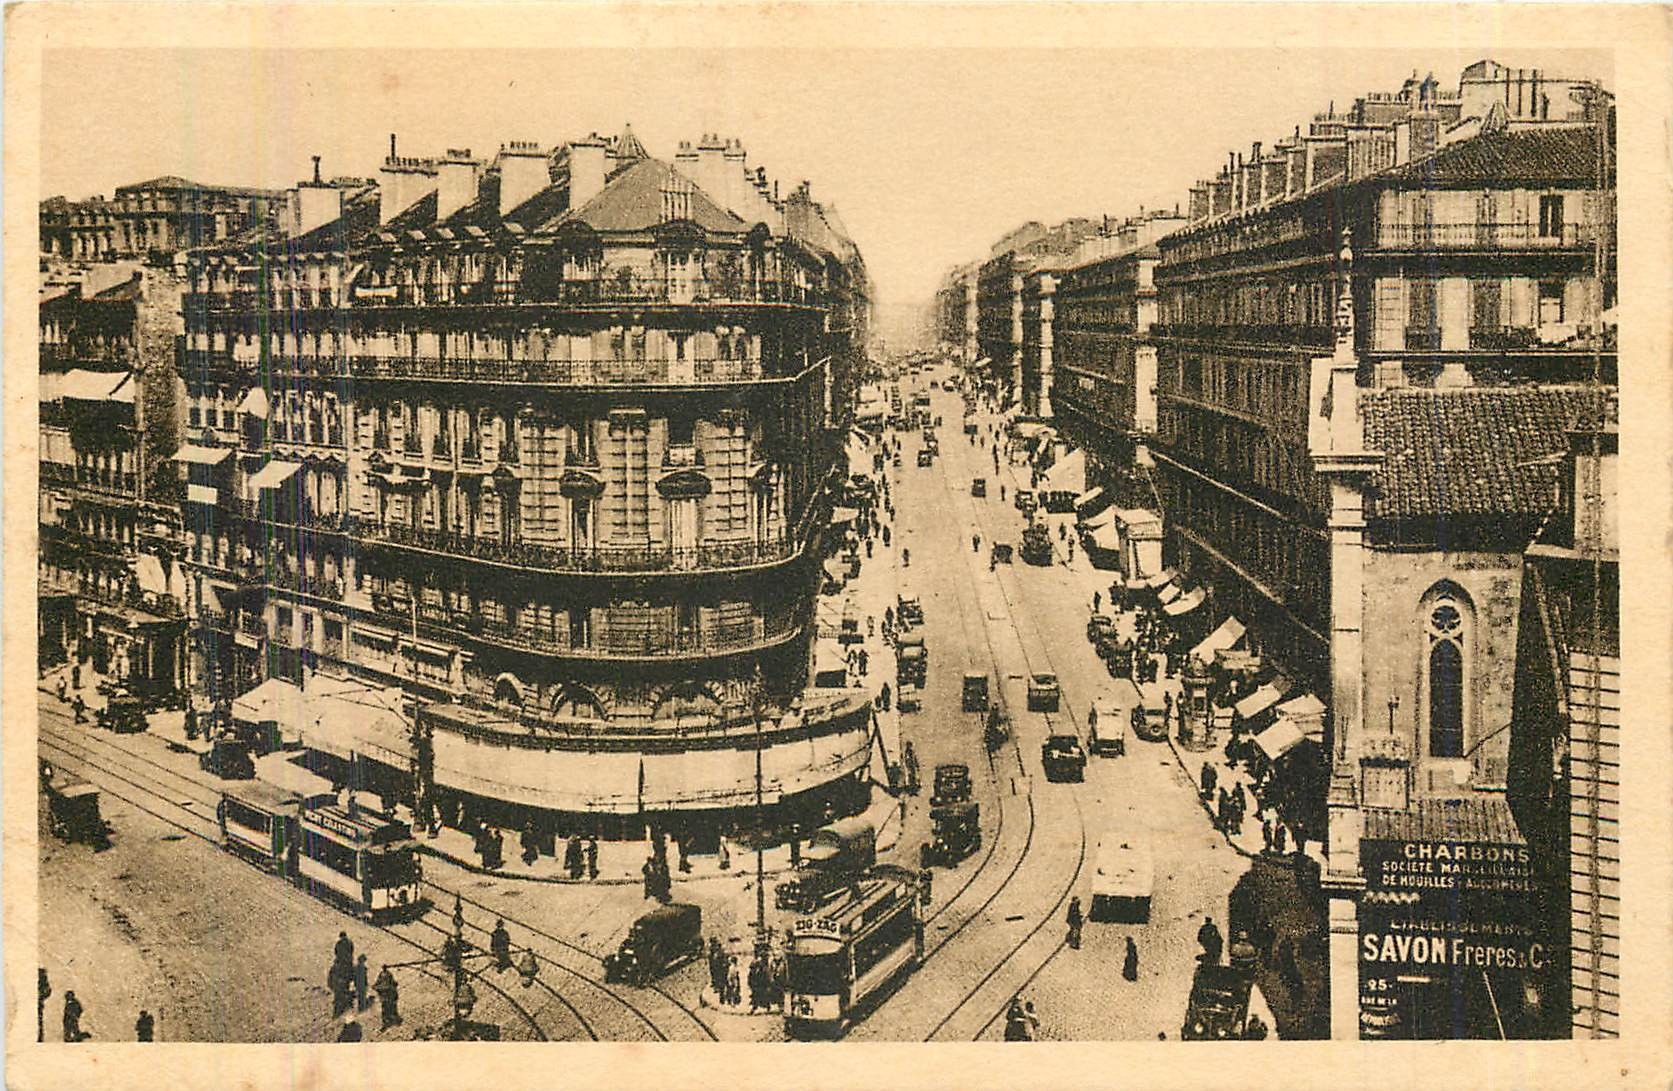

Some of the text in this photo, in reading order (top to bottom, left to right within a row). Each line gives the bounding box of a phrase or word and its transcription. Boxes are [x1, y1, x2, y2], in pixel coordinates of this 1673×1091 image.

[1404, 843, 1530, 863] CHARBONS
[1382, 860, 1433, 873] SOCIETE
[1382, 876, 1396, 886] DE
[1363, 933, 1446, 964] SAVON
